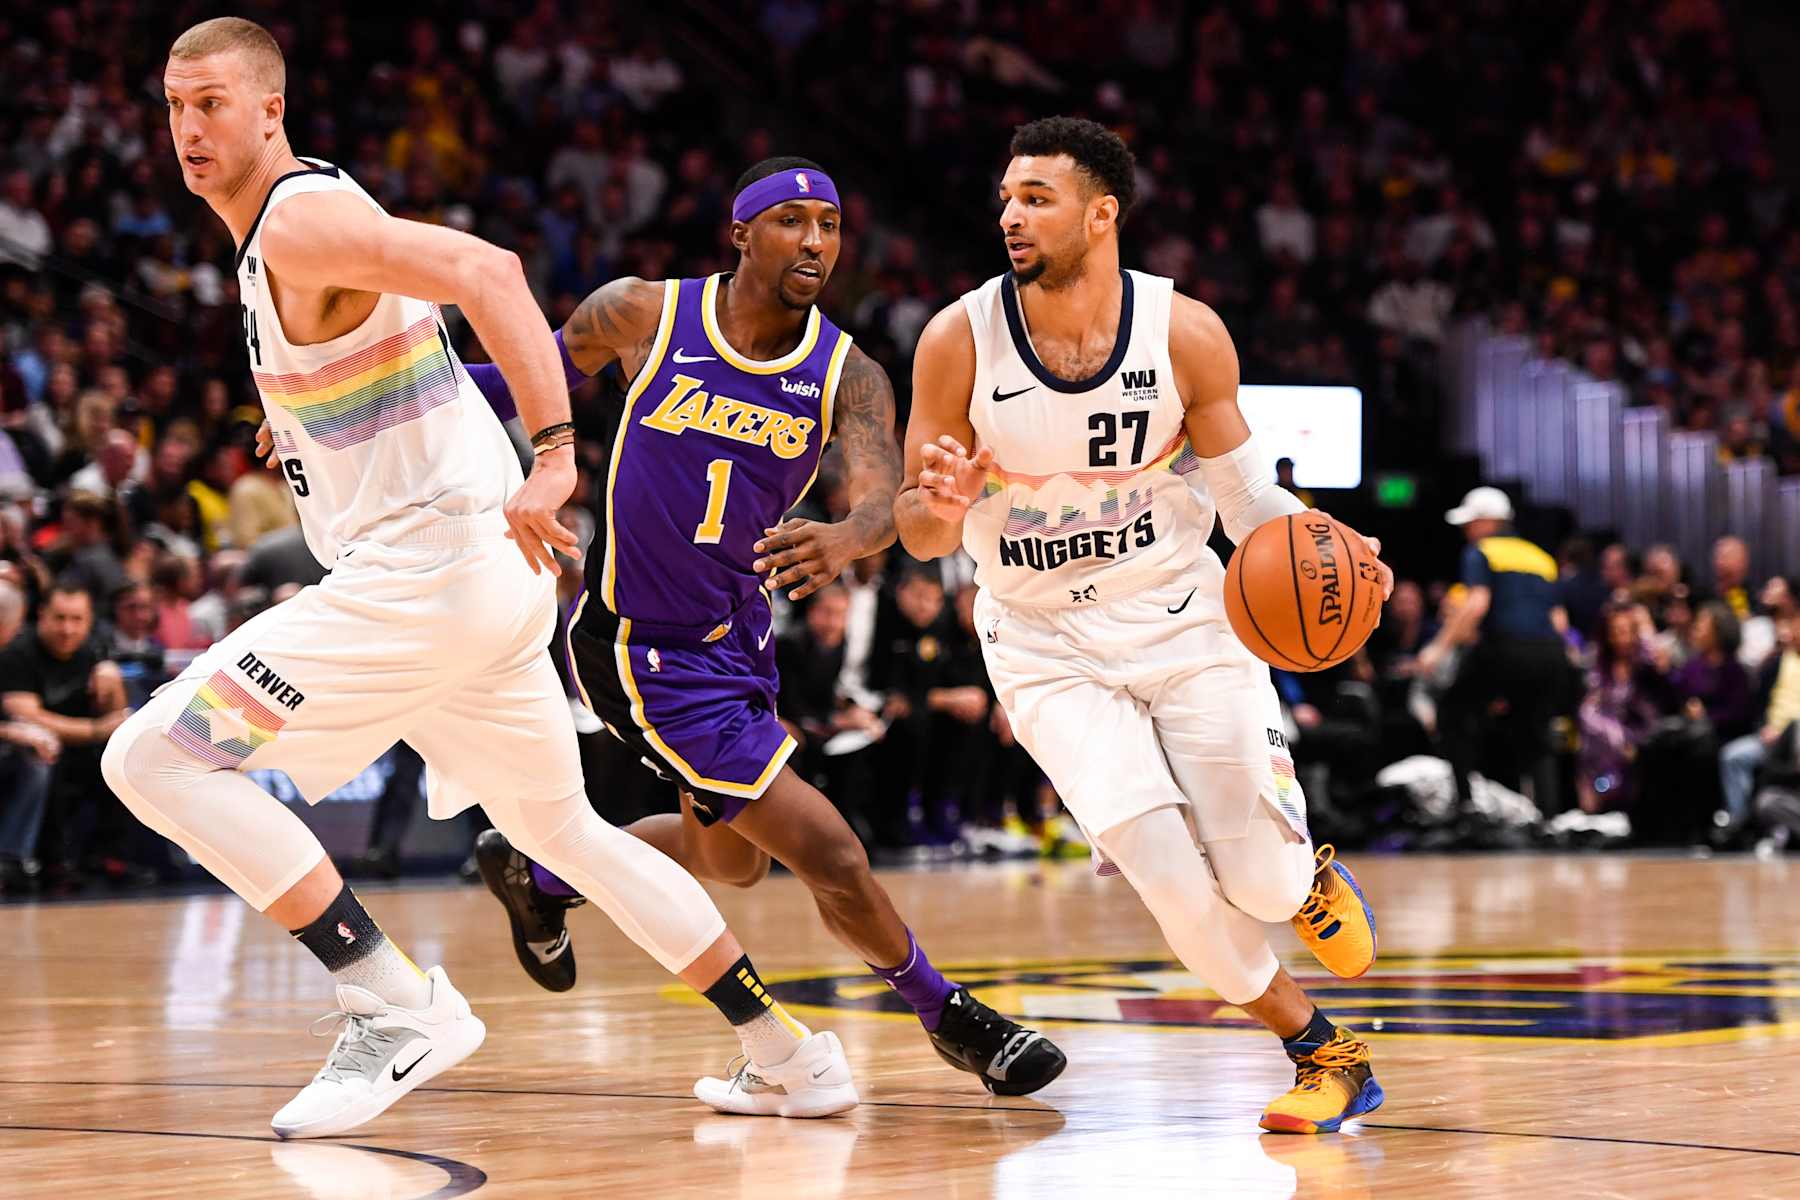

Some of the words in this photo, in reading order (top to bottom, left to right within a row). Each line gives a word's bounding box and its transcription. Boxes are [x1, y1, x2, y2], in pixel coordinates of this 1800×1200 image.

[779, 376, 821, 399] wish
[1121, 369, 1156, 389] WU
[1121, 388, 1158, 397] WESTERN
[639, 373, 817, 460] LAKERS
[1088, 410, 1150, 467] 27
[693, 458, 734, 545] 1
[1000, 510, 1156, 571] NUGGETS
[1304, 523, 1343, 626] SPALDING
[236, 651, 305, 712] DENVER
